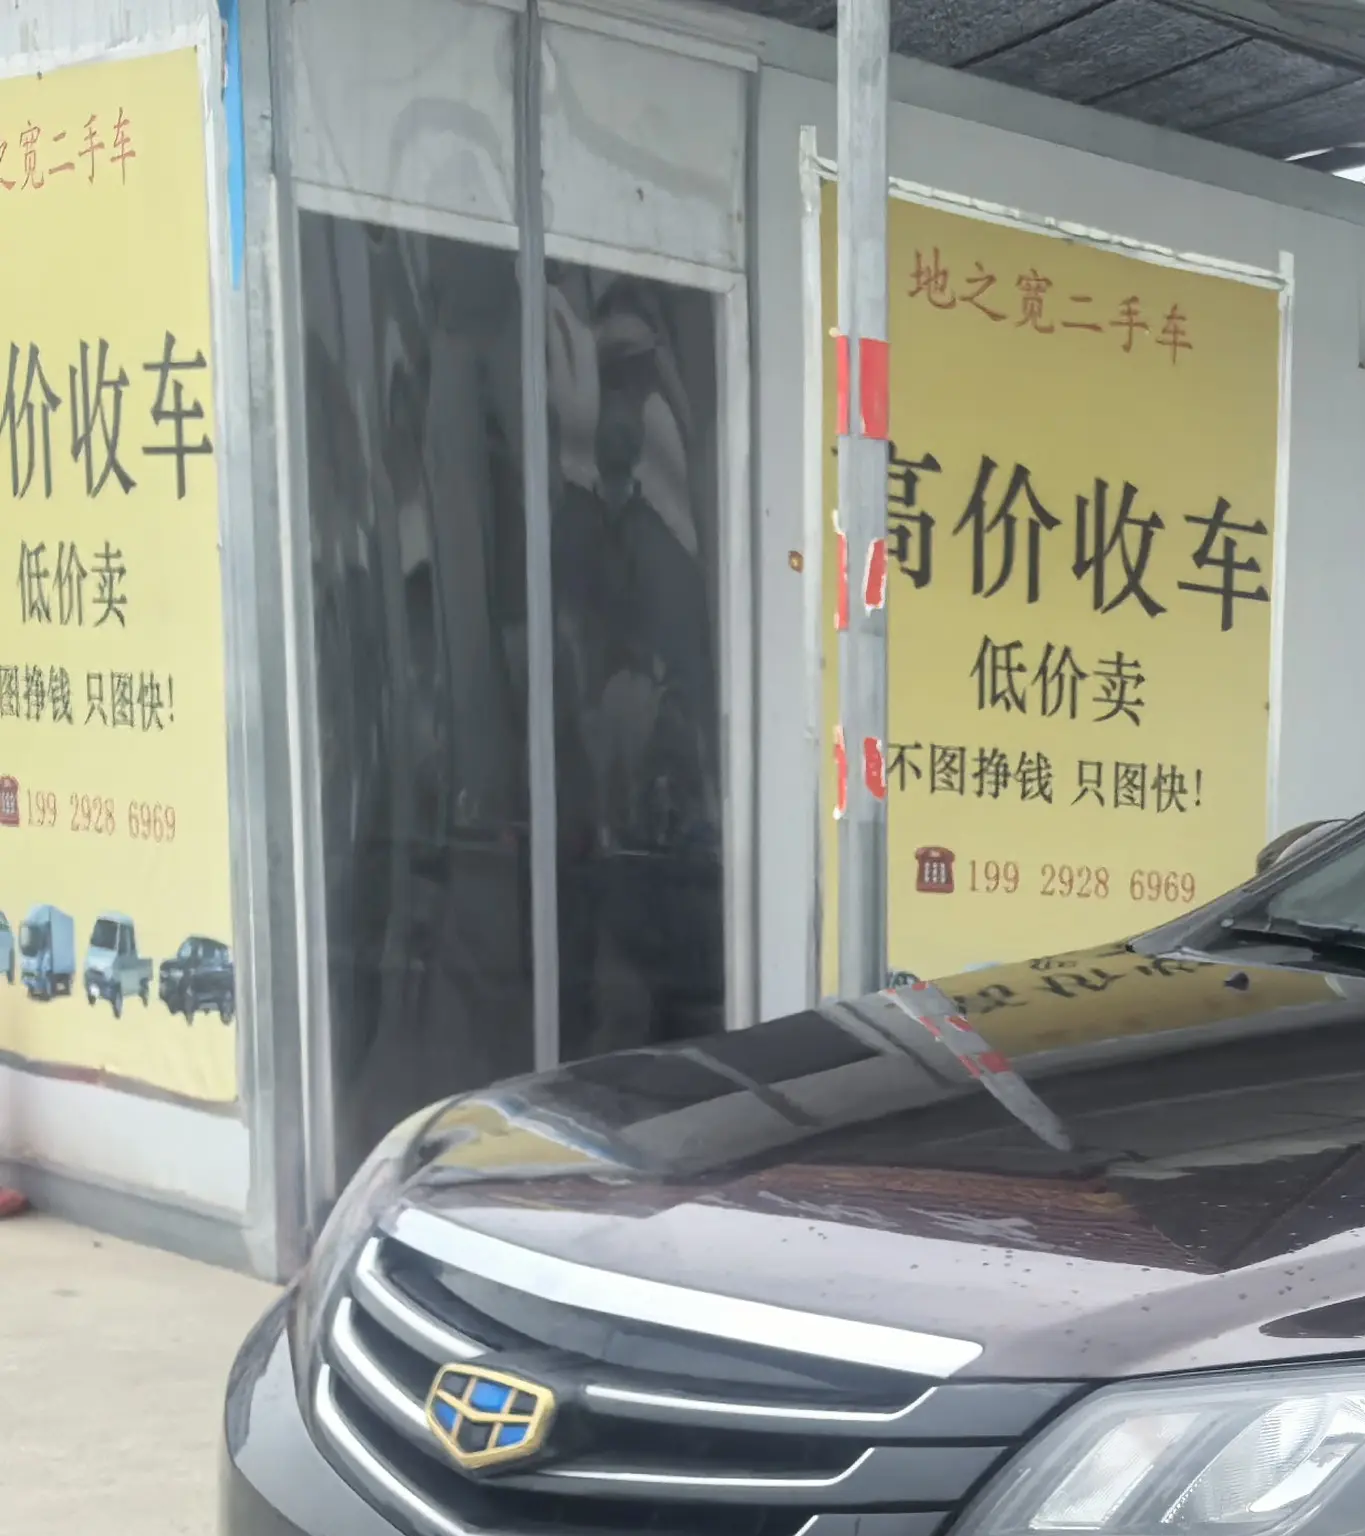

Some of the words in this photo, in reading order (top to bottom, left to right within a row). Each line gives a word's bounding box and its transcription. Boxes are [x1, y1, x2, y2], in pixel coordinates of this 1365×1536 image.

[908, 246, 1193, 365] 地之宽二手车
[0, 330, 213, 500] 价收车
[18, 540, 128, 628] 低价卖
[969, 635, 1146, 727] 低价卖
[28, 787, 57, 827] 199
[70, 792, 115, 836] 2928
[129, 800, 176, 842] 6969
[887, 740, 1053, 804] 不图挣钱
[1071, 759, 1204, 813] 只图快!
[968, 859, 1020, 894] 199
[1040, 863, 1110, 899] 2928
[1130, 869, 1196, 903] 6969
